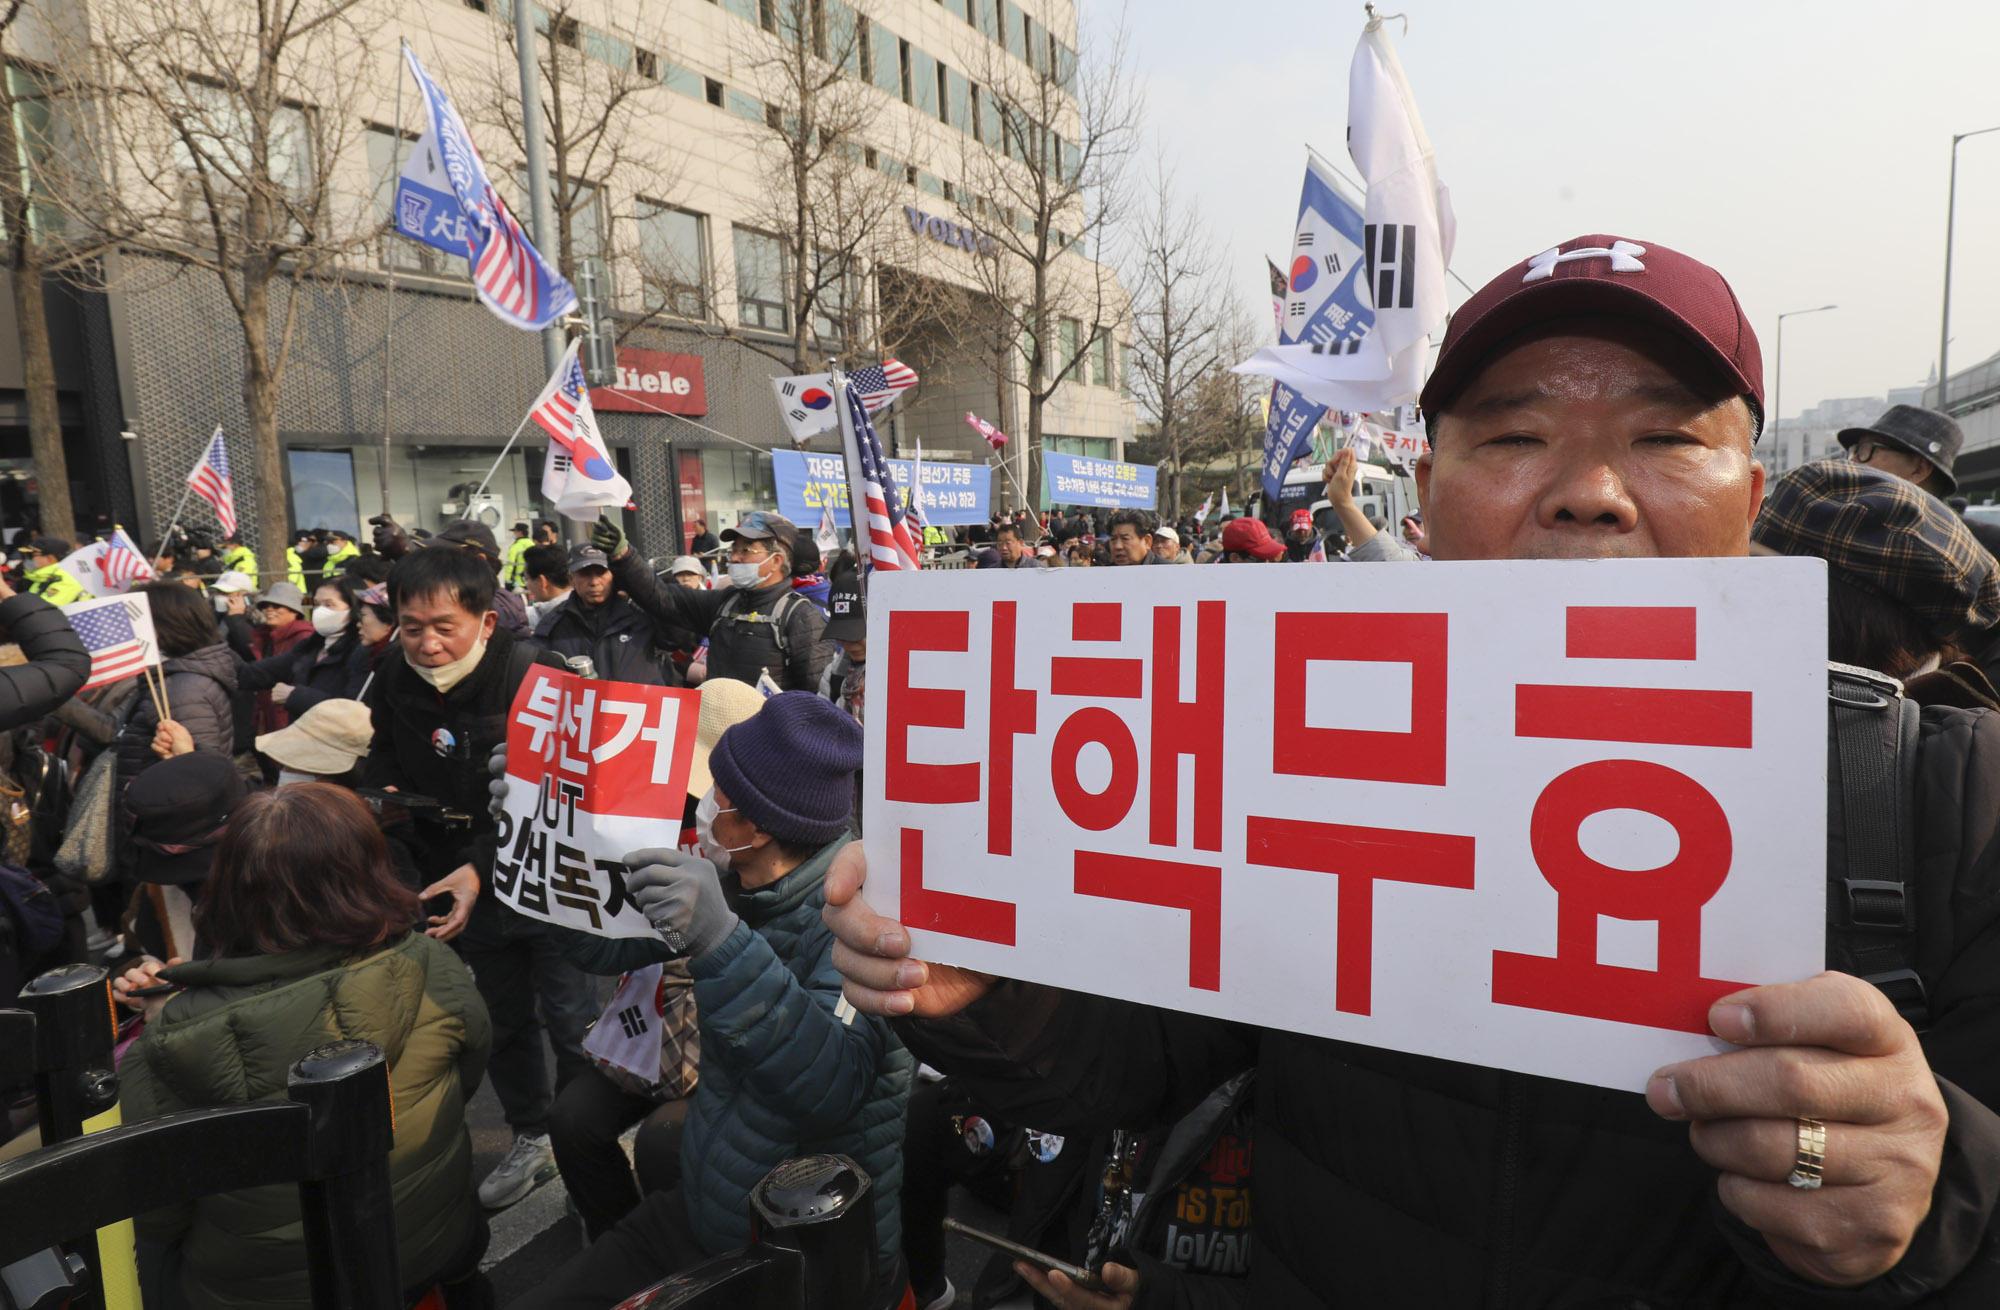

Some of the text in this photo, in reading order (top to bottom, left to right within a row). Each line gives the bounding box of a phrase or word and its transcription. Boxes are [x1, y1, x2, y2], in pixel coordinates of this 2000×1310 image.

[911, 465, 951, 484] 법선거
[953, 467, 972, 485] 주동
[1095, 462, 1114, 479] 하수인
[1116, 464, 1137, 481] 오동운
[1057, 475, 1086, 494] 공수처장
[939, 490, 957, 508] 수사
[959, 491, 976, 508] 하라
[886, 600, 1752, 1036] 탄핵무효
